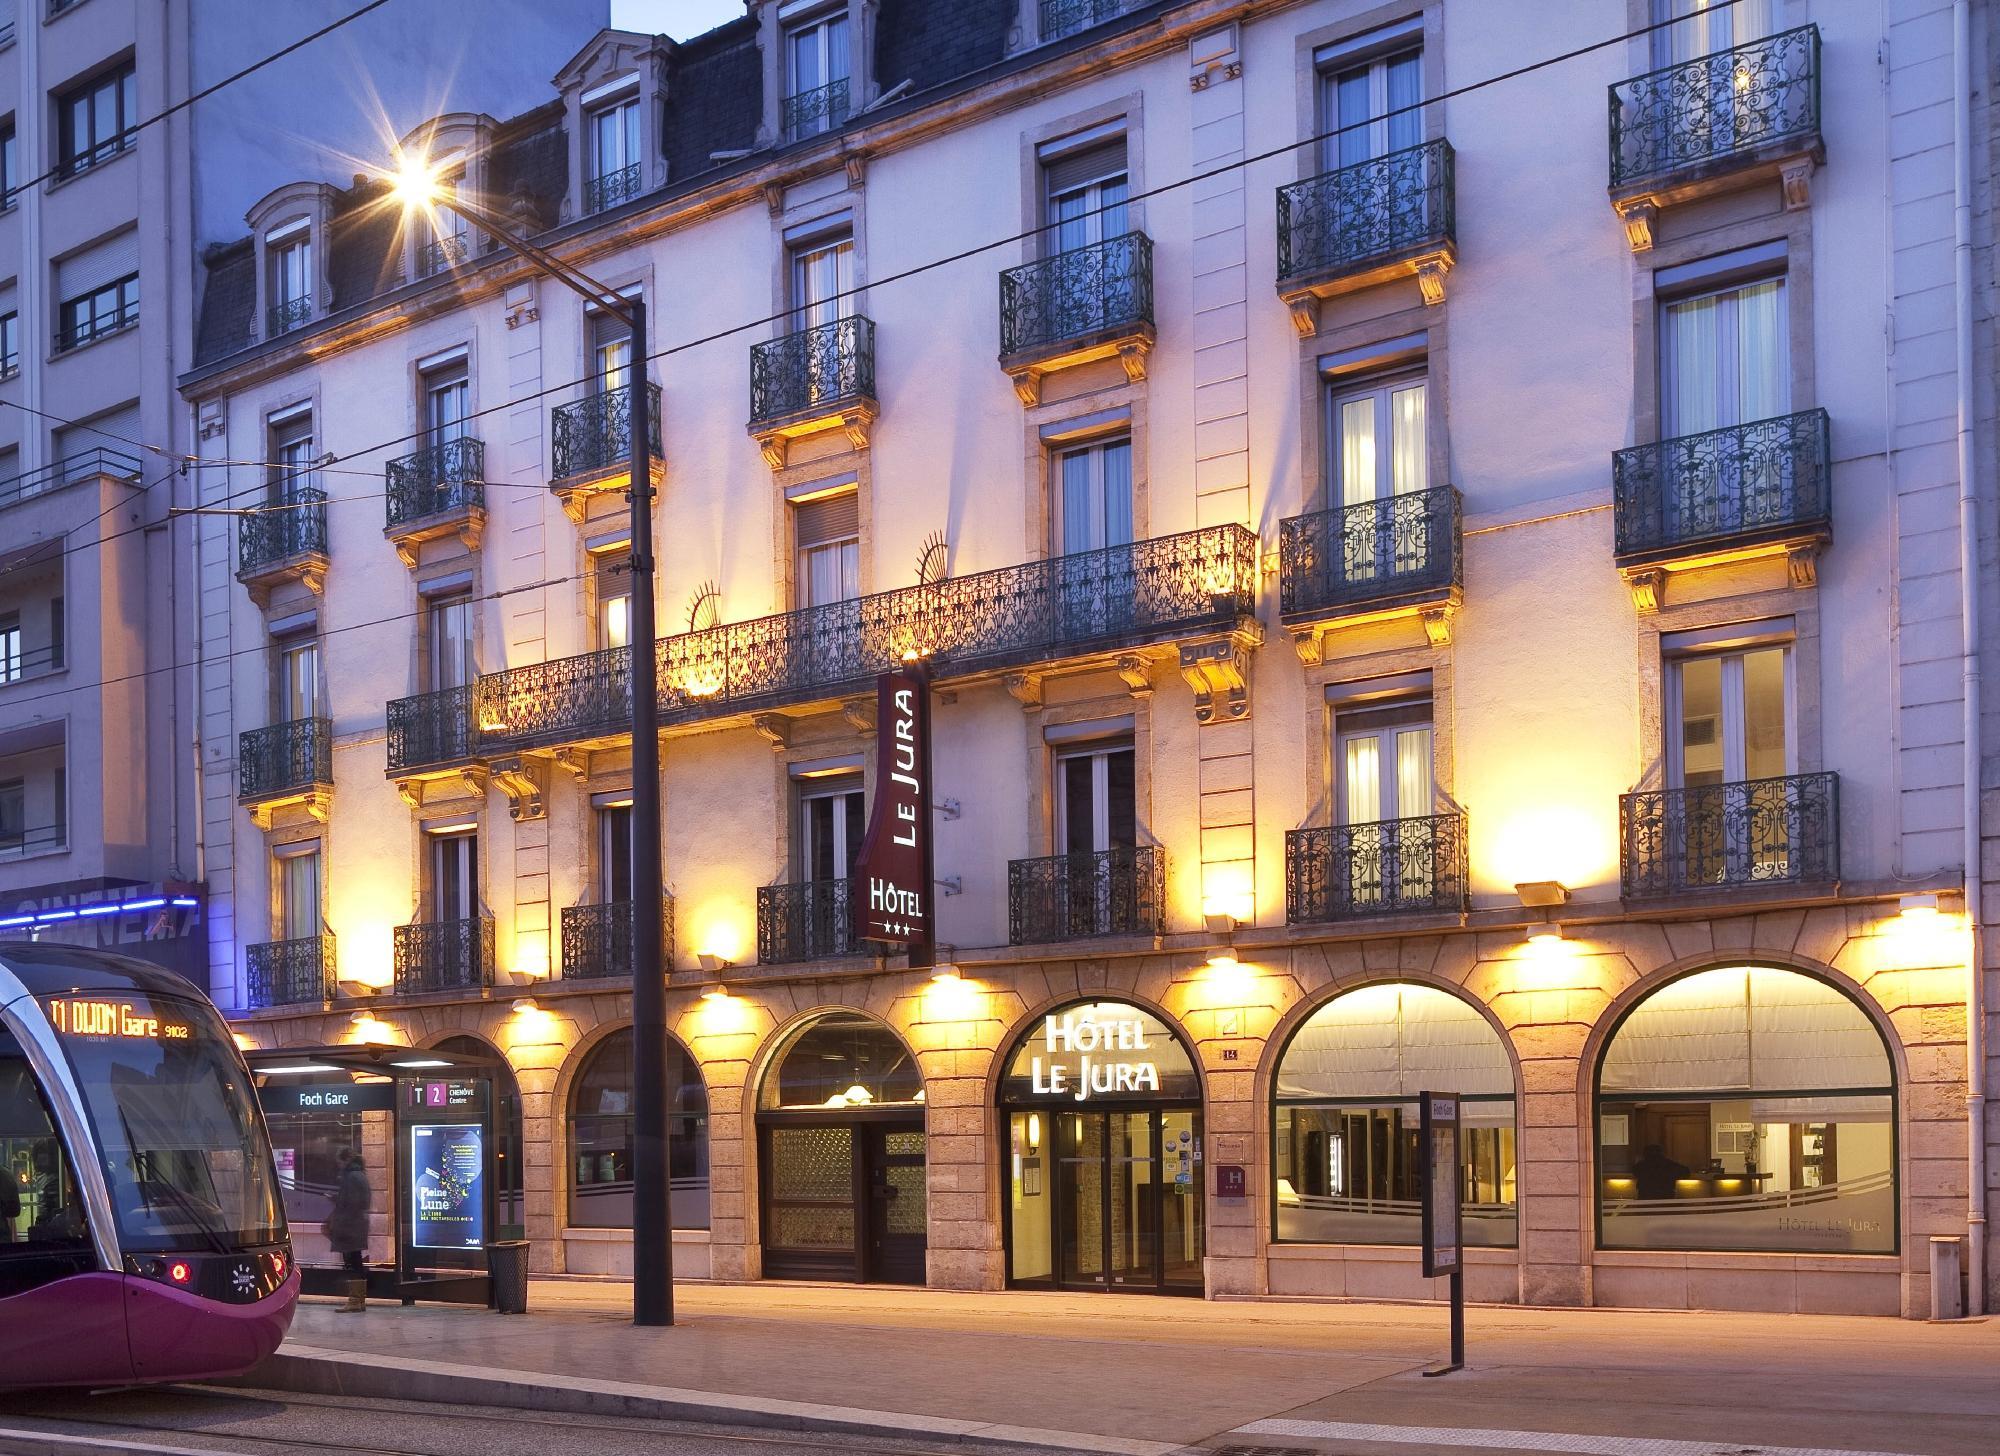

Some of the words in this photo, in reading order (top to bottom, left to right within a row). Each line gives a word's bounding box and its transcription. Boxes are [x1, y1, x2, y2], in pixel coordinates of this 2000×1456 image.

[891, 689, 920, 796] JURA
[893, 803, 917, 848] LE
[870, 877, 923, 918] HÔTEL
[51, 1001, 66, 1033] T1
[73, 1001, 116, 1035] DIJON
[122, 1004, 158, 1037] Gare
[1046, 1014, 1149, 1053] HÔTEL
[1226, 1050, 1235, 1059] 14
[1032, 1056, 1067, 1094] LE
[1075, 1055, 1160, 1101] JURA
[300, 1092, 322, 1106] Foch
[325, 1091, 349, 1105] Gare
[415, 1087, 423, 1103] T
[433, 1087, 440, 1103] 2
[1229, 1172, 1241, 1184] H
[420, 1186, 447, 1198] Pleine
[420, 1199, 450, 1210] Lune
[1779, 1217, 1822, 1231] HÔTEL
[1845, 1217, 1881, 1234] JURA
